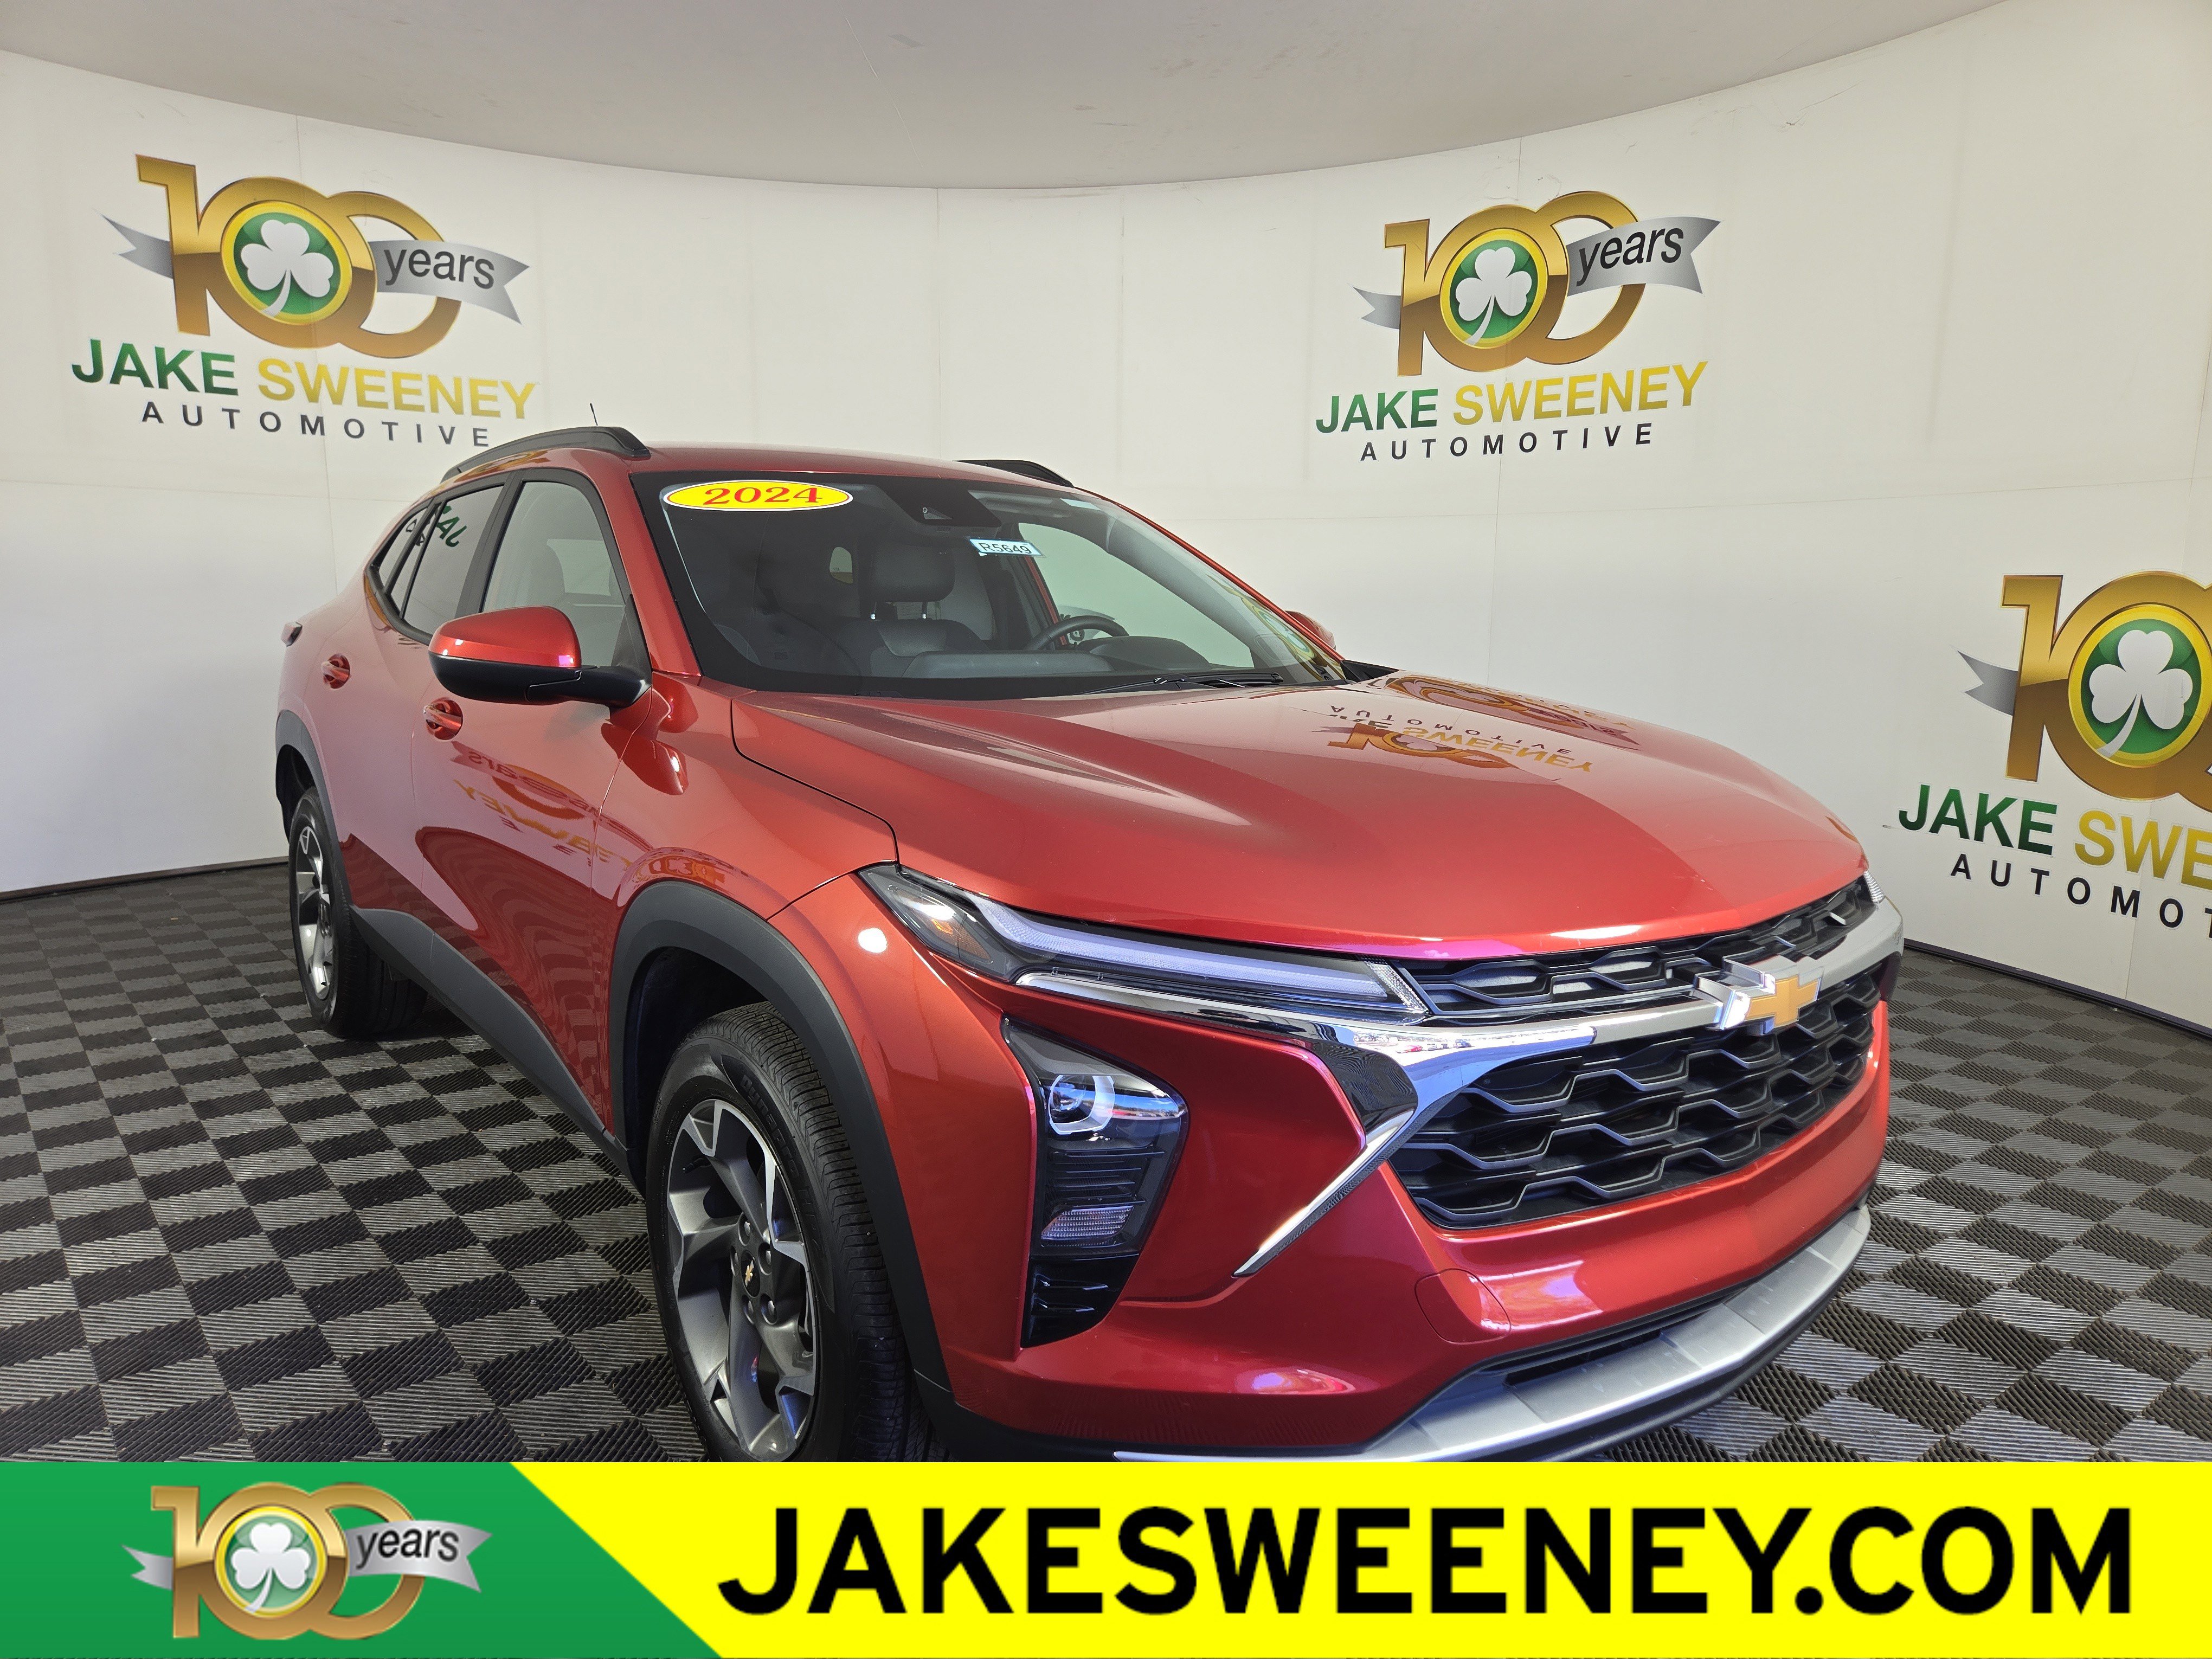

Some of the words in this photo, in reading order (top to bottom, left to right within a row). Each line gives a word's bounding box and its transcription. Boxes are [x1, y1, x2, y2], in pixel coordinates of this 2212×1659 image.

[136, 154, 462, 358] 100
[383, 249, 496, 290] years
[1384, 191, 1647, 377] 100
[1576, 228, 1684, 287] years
[72, 339, 239, 396] JAKE
[258, 358, 536, 420] SWEENEY
[1316, 388, 1438, 434] JAKE
[1454, 362, 1708, 426] SWEENEY
[142, 402, 489, 446] AUTOMOTIVE
[1360, 423, 1652, 461] AUTOMOTIVE
[703, 487, 822, 505] 2024
[978, 542, 1032, 554] R5649
[1899, 785, 2057, 856] JAKE
